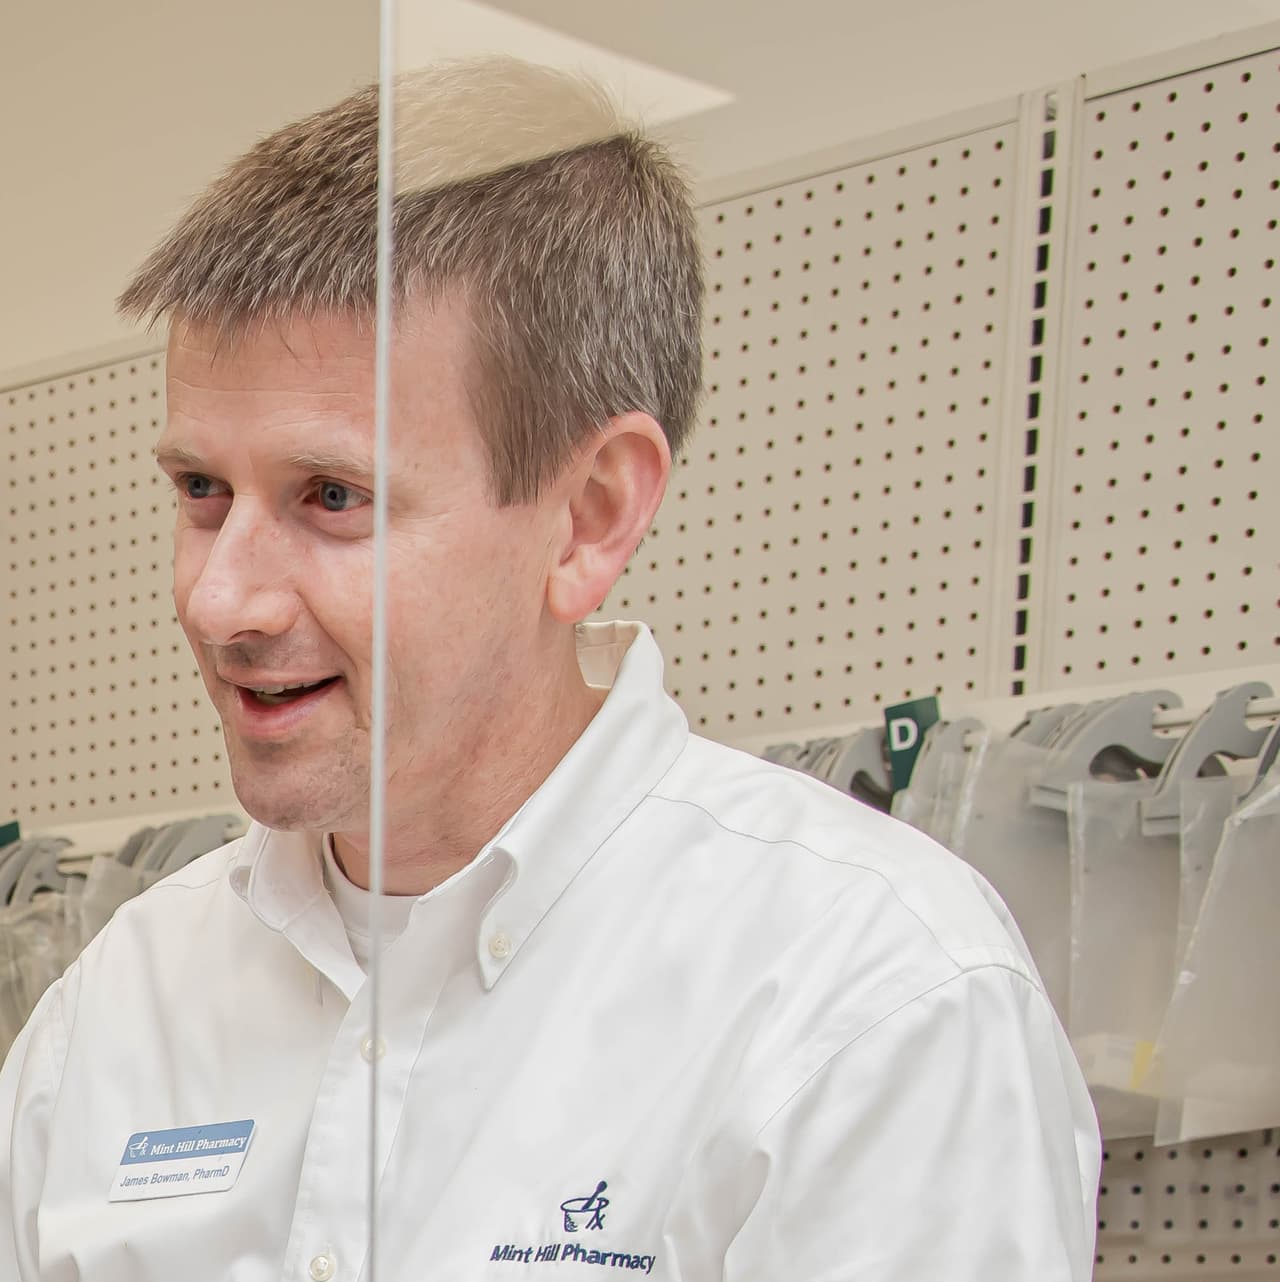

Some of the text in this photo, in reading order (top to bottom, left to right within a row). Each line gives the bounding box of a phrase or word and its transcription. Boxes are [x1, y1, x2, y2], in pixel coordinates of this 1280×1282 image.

[888, 716, 919, 750] D
[150, 1136, 248, 1156] Mint Hill Pharmacy
[120, 1165, 230, 1188] James Bowman, PharmD
[490, 1243, 656, 1275] Mint Hill Pharmacy
